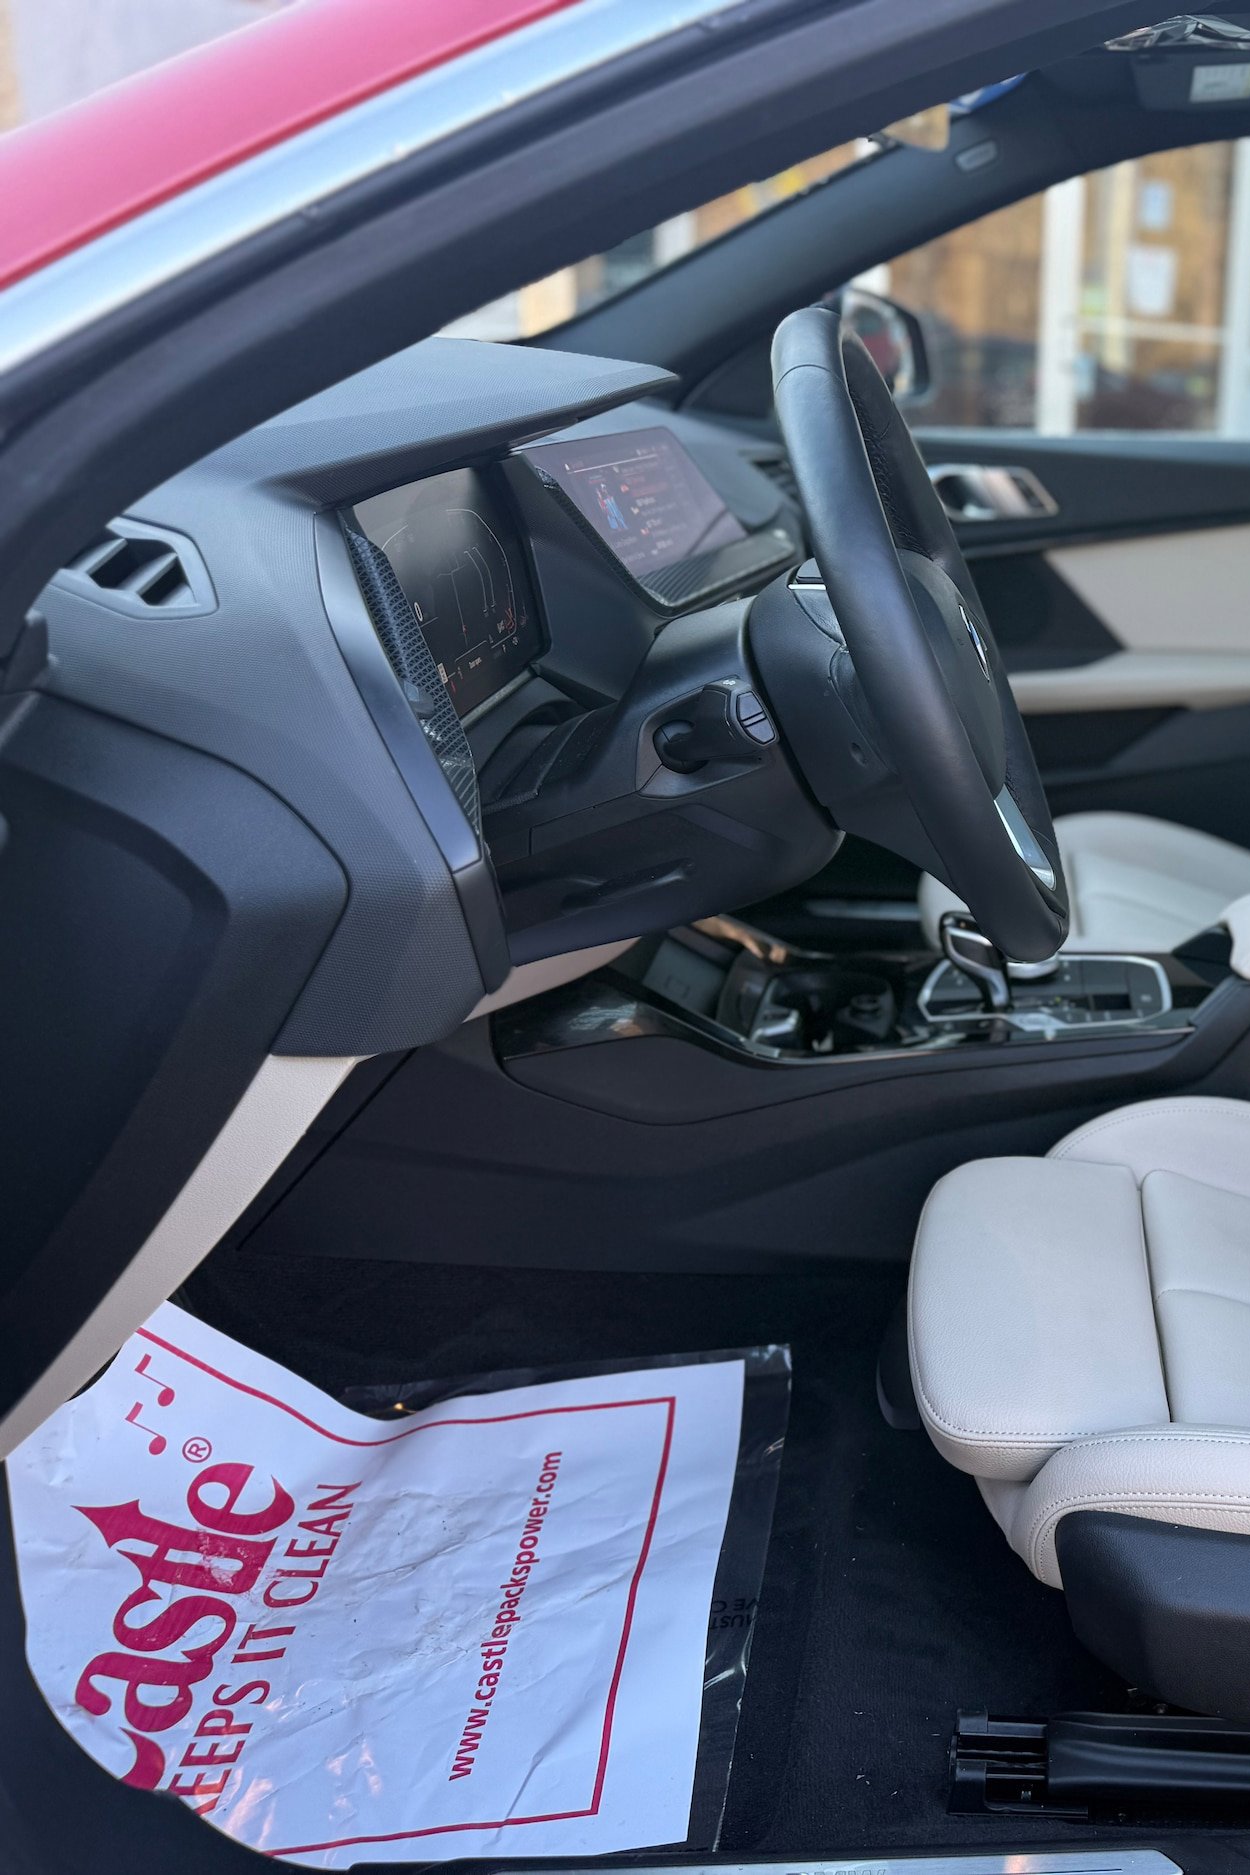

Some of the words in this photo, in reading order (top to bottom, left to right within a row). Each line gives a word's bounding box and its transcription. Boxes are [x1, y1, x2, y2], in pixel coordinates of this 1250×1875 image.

[263, 1480, 363, 1609] CLEAN
[230, 1622, 297, 1664] IT
[449, 1451, 563, 1782] www.castlepackspower.com
[168, 1679, 271, 1816] EEPS
